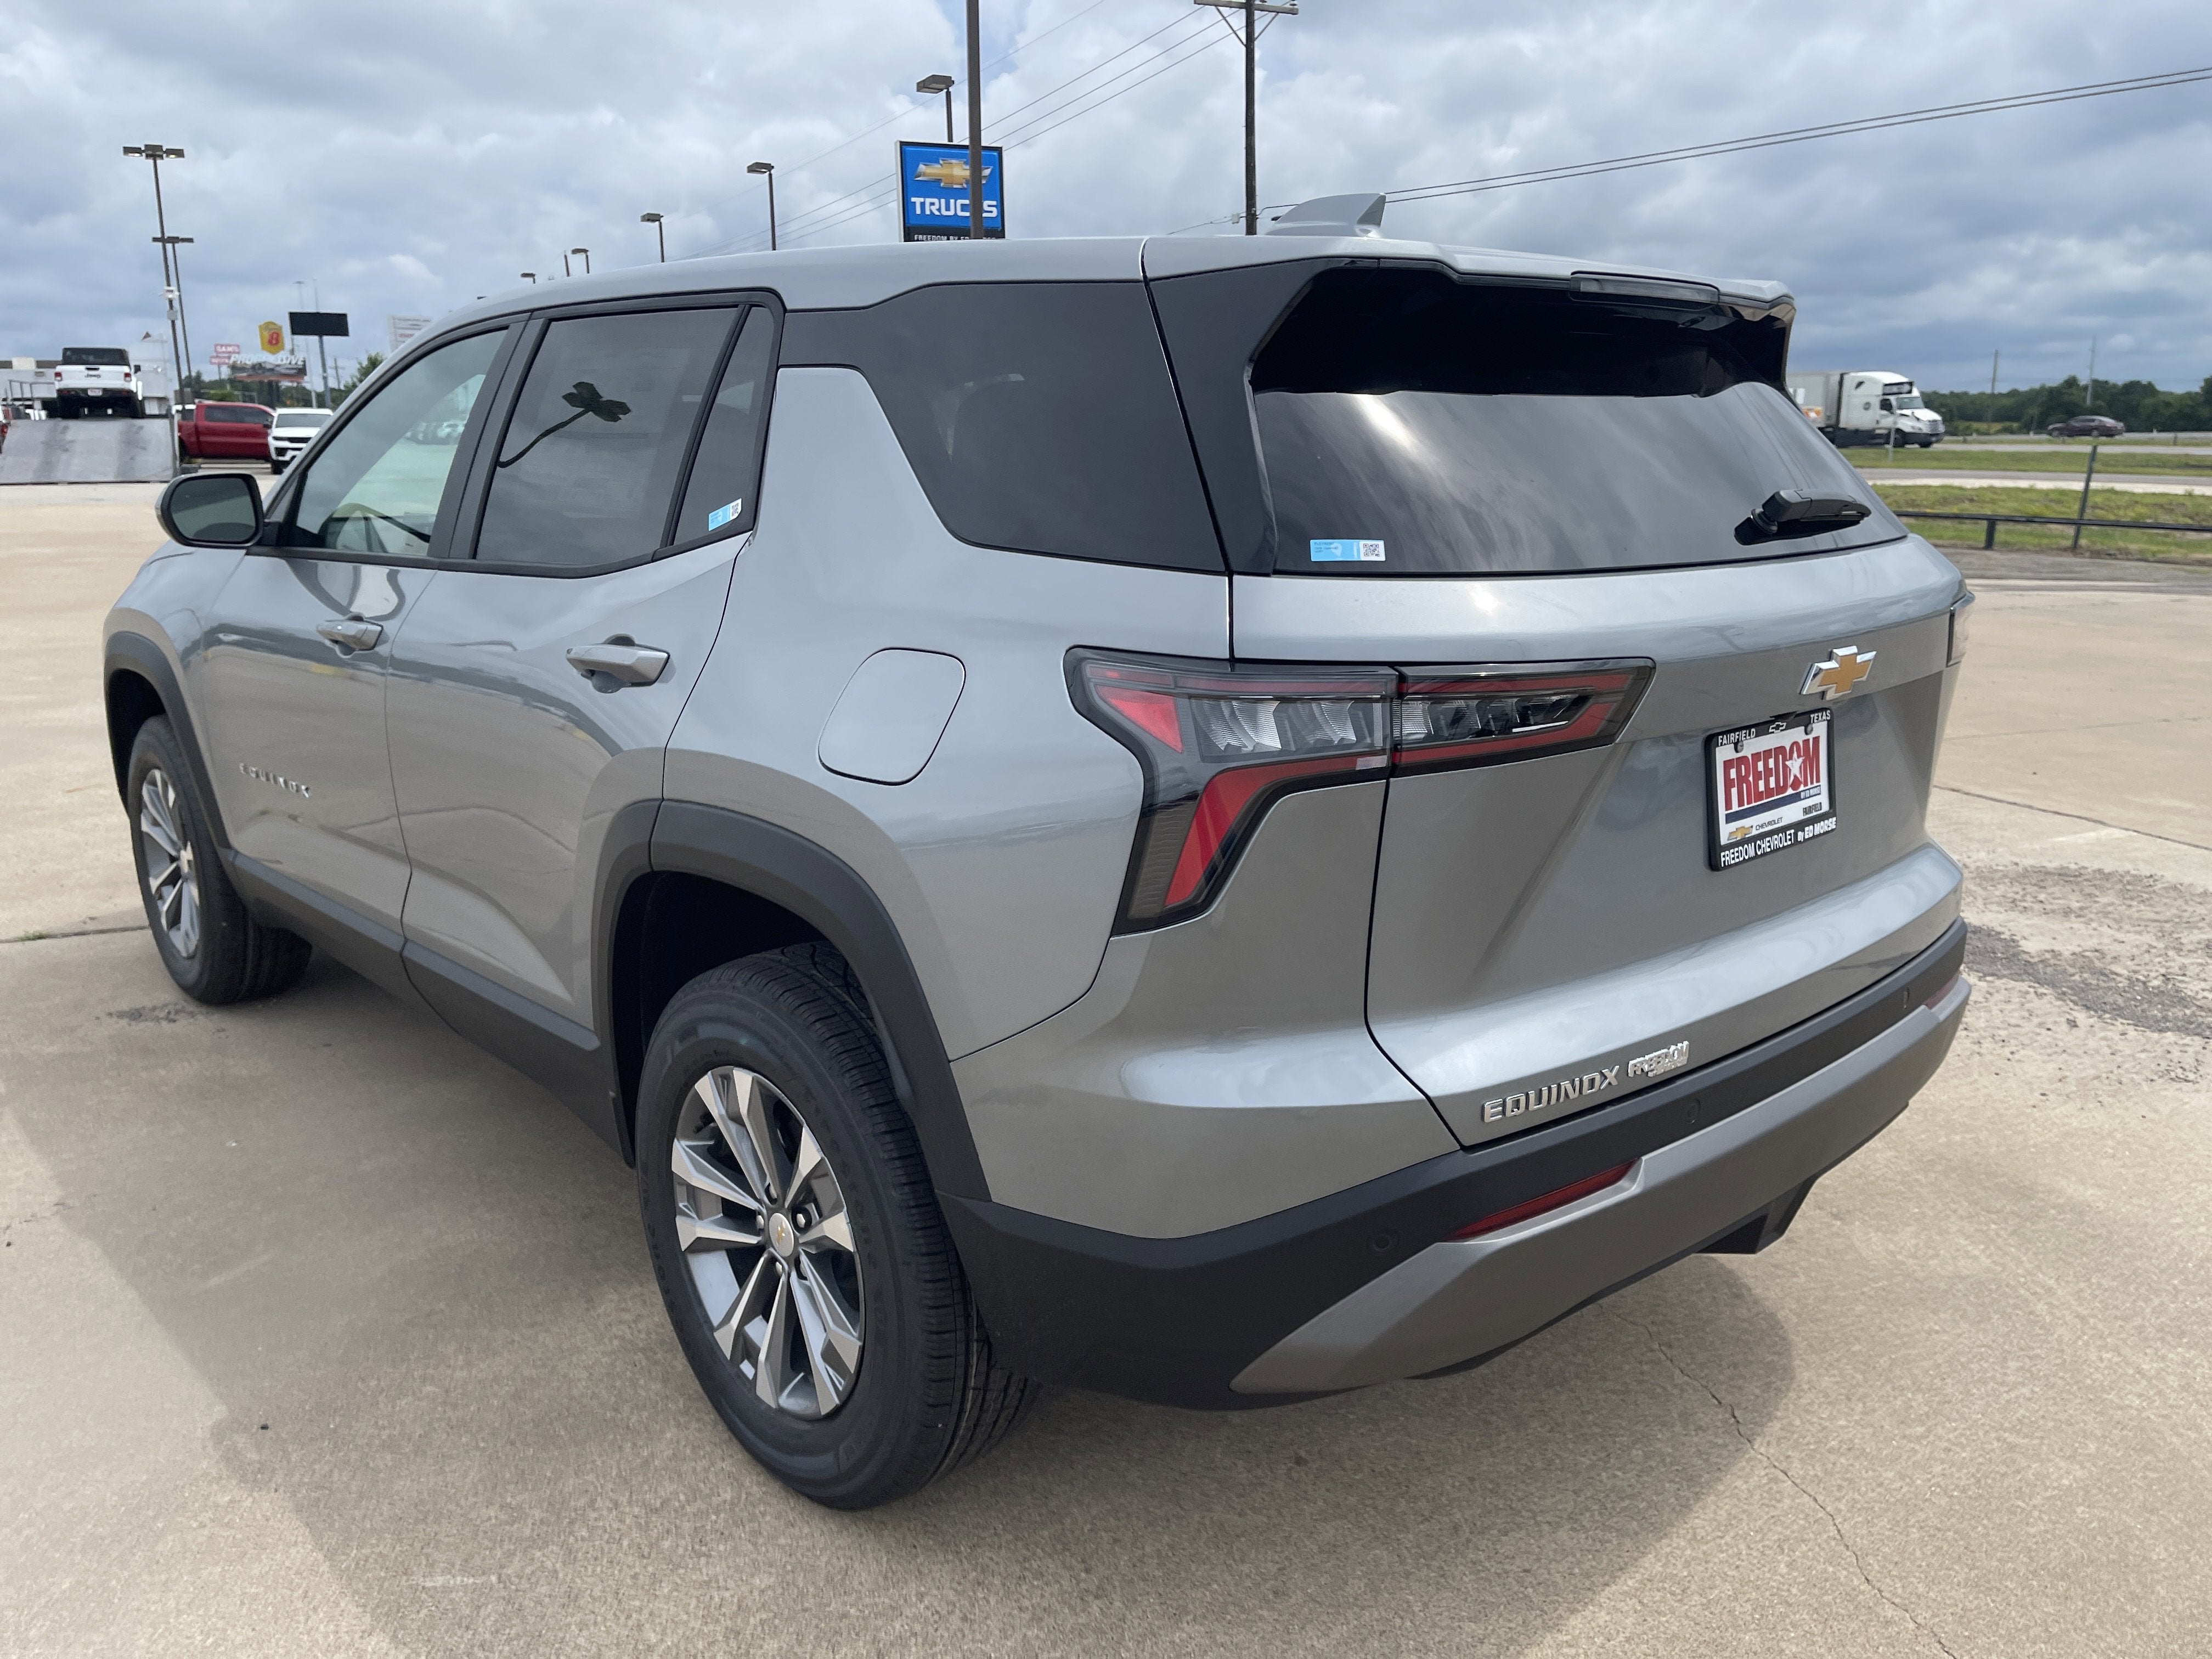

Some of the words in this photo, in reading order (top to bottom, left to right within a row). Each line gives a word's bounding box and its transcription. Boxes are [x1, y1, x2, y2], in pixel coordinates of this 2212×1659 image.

[911, 197, 997, 217] TRUCS
[267, 331, 280, 346] 8
[1718, 729, 1756, 747] FAIRFIELD
[1810, 710, 1831, 724] TEXAS
[239, 762, 310, 798] EQUINOX
[1723, 736, 1820, 811] FREEDOM
[1755, 816, 1783, 831] CHEVROLET
[1802, 802, 1822, 817] FAIRFIELD
[1720, 842, 1756, 868] FREEDOM
[1756, 829, 1795, 855] CHEVROLET
[1804, 825, 1814, 839] ED
[1814, 816, 1837, 836] MORSE
[1483, 1065, 1620, 1122] EQUINOX
